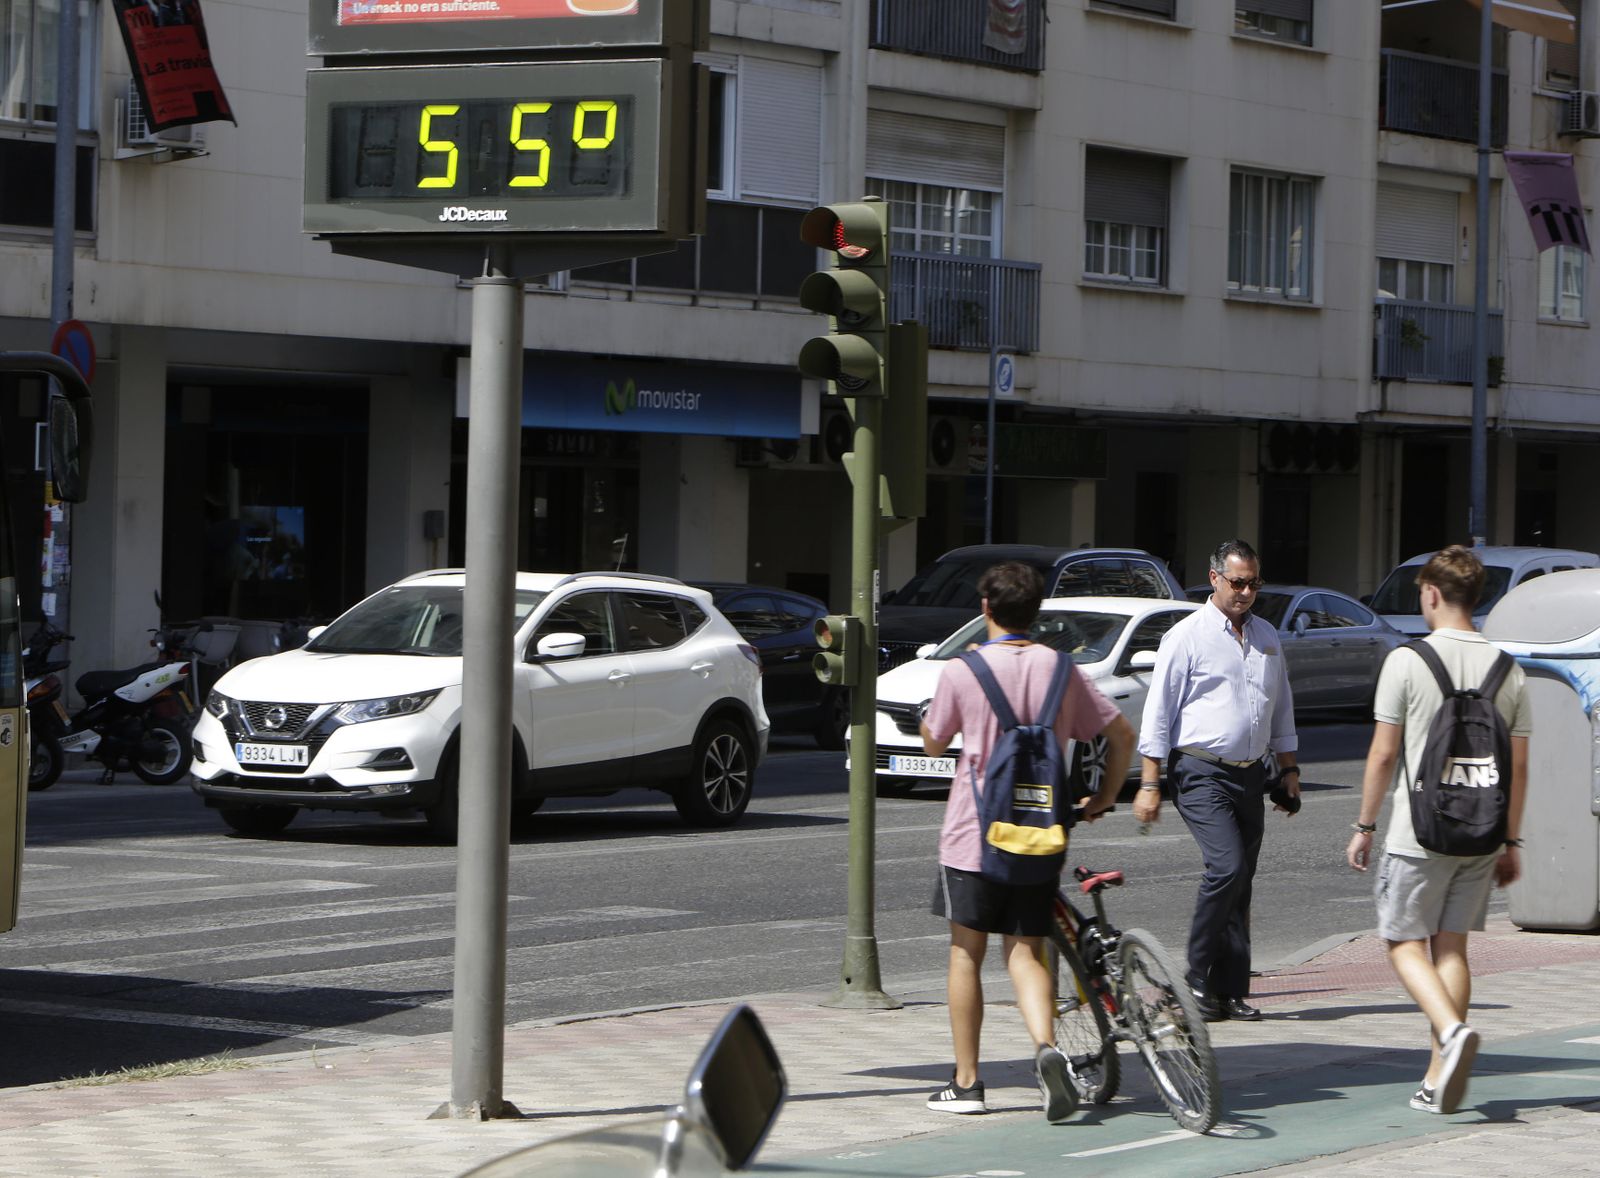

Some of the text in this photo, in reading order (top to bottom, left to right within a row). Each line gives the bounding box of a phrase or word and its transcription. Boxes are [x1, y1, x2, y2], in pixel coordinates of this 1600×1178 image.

[369, 1, 402, 13] snack
[403, 3, 418, 13] no
[419, 2, 438, 13] era
[440, 0, 499, 12] suficiente.
[143, 61, 168, 76] La
[438, 206, 508, 222] JCDecaux
[637, 389, 701, 410] movistar
[244, 746, 275, 761] 9334
[899, 758, 953, 773] 1339 KZK
